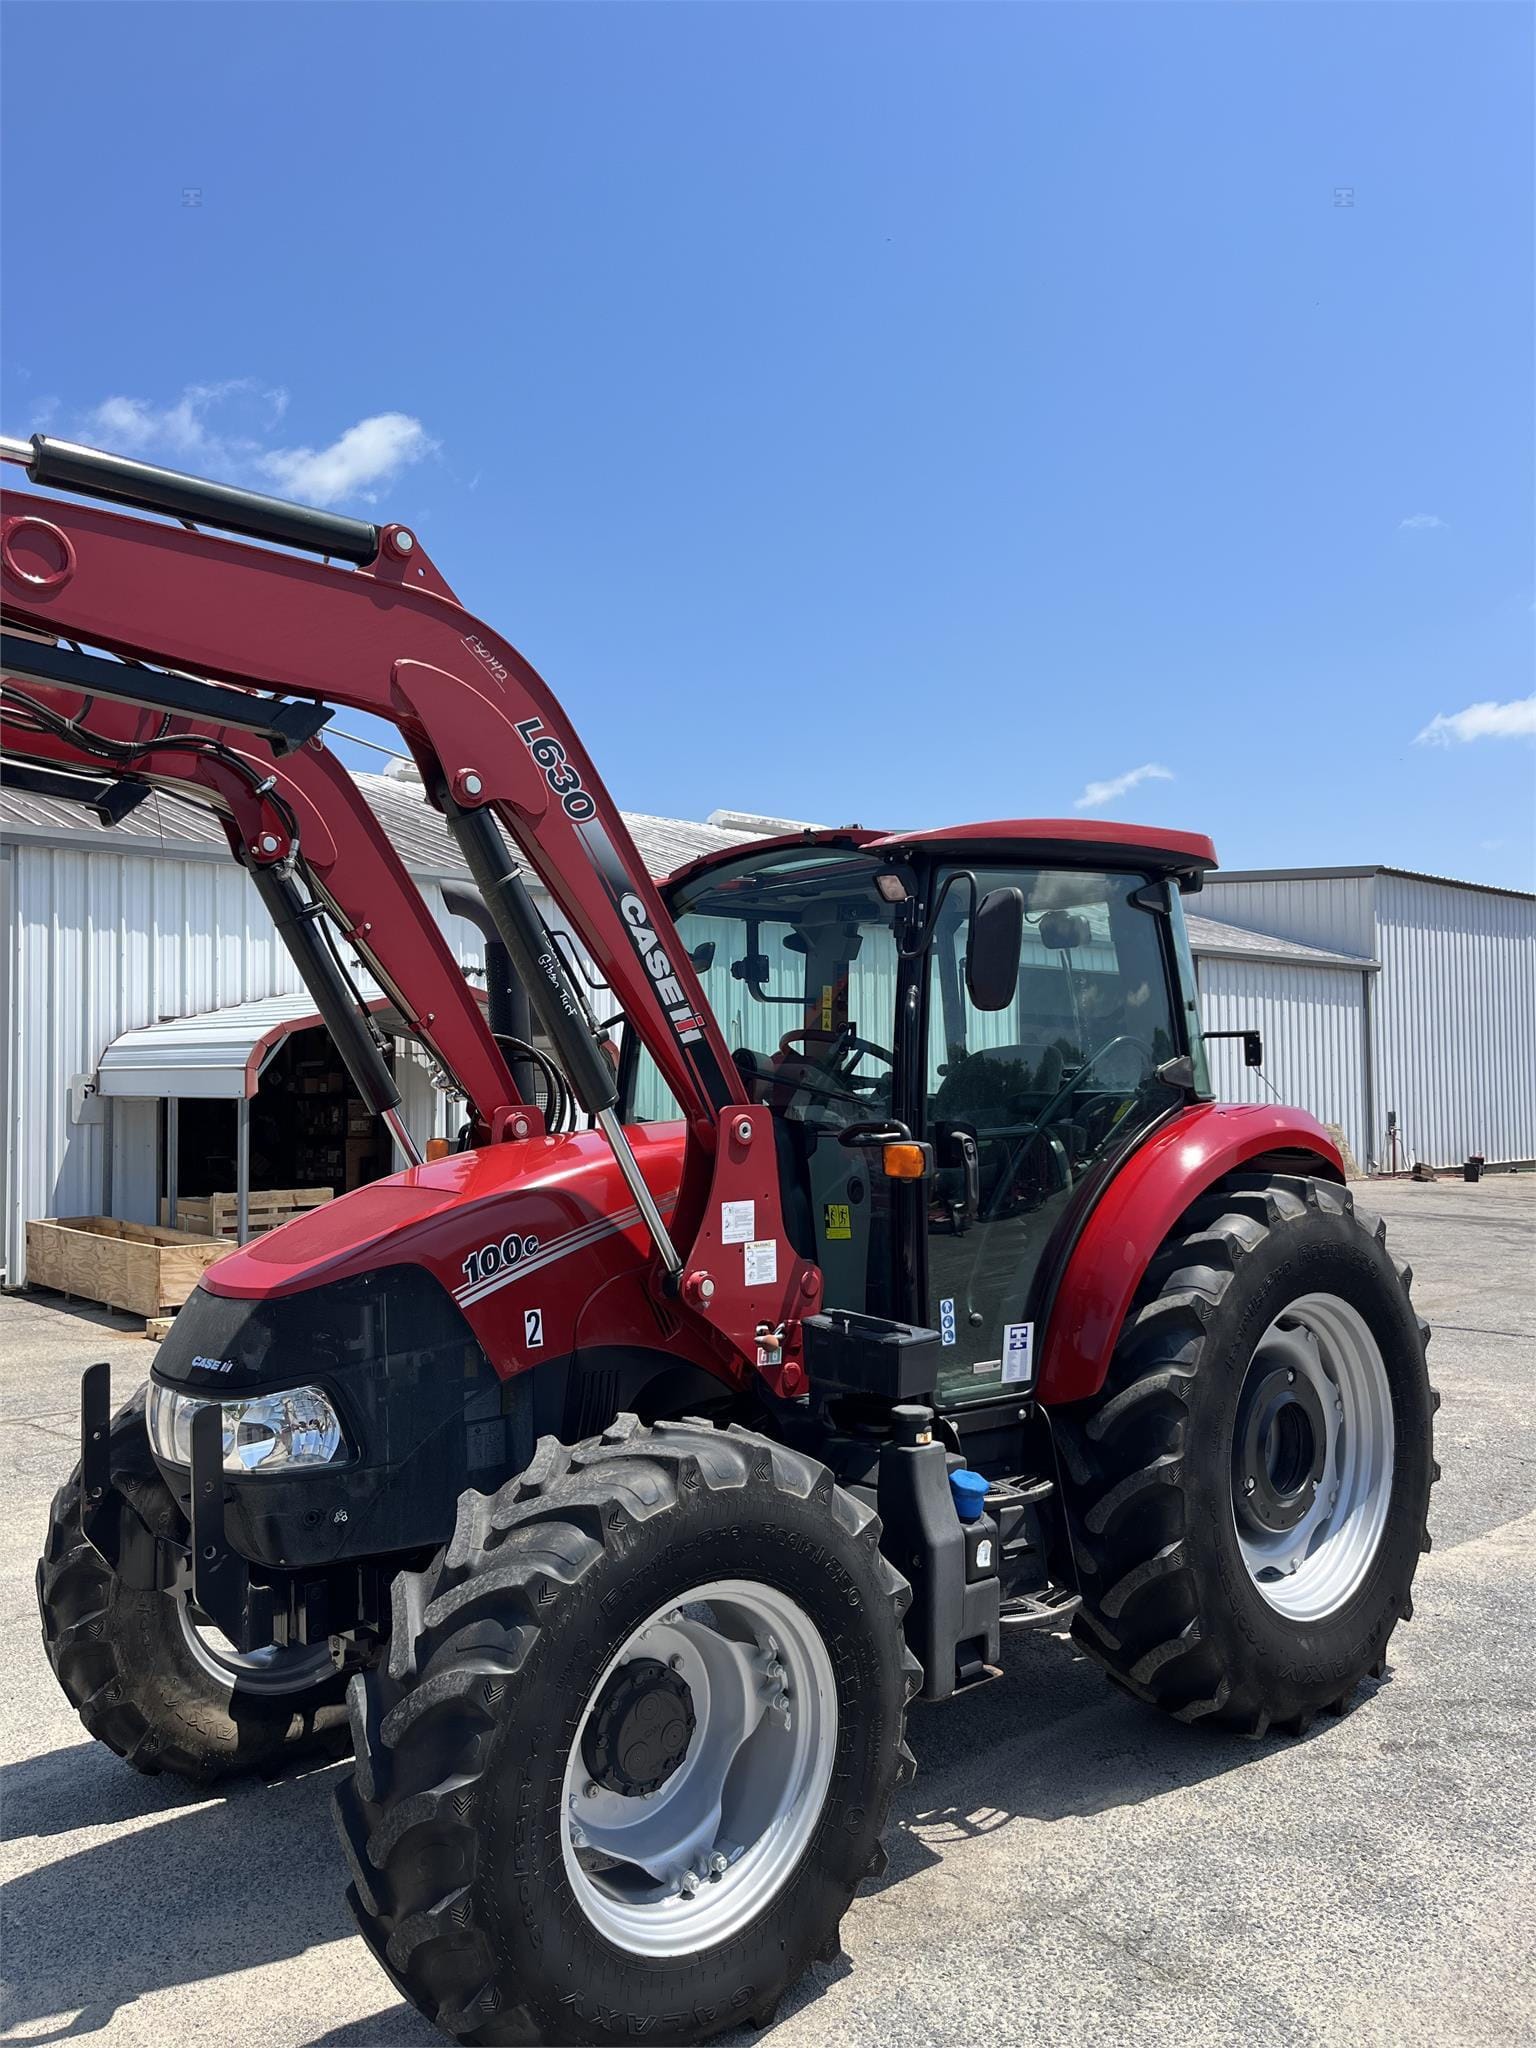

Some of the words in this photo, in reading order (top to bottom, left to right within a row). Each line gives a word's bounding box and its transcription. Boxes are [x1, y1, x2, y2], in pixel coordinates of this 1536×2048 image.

[514, 716, 597, 822] L630
[620, 892, 685, 1005] CASE
[192, 1355, 221, 1370] CASE
[526, 1311, 542, 1346] 2
